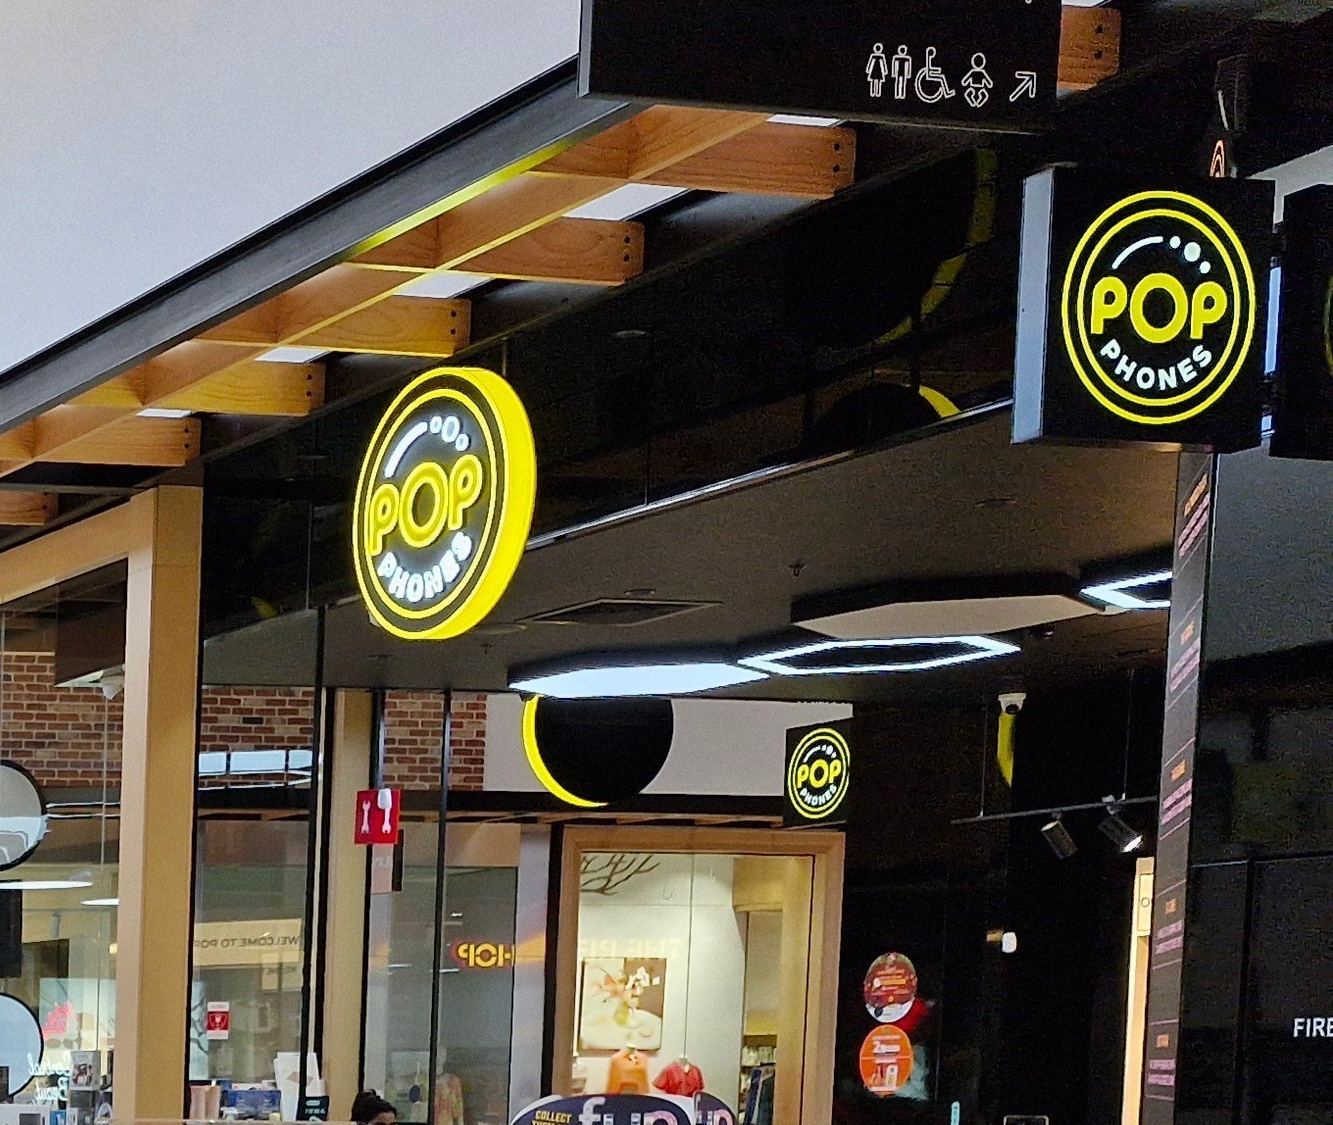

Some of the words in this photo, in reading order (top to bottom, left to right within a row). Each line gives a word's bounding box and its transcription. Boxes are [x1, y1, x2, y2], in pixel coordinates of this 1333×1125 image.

[1090, 272, 1228, 344] POP
[1100, 338, 1213, 391] PHONES
[367, 454, 483, 557] POP
[377, 531, 473, 603] PHONES
[796, 759, 842, 789] POP
[799, 783, 838, 807] PHONES
[534, 1109, 572, 1123] COLLECT
